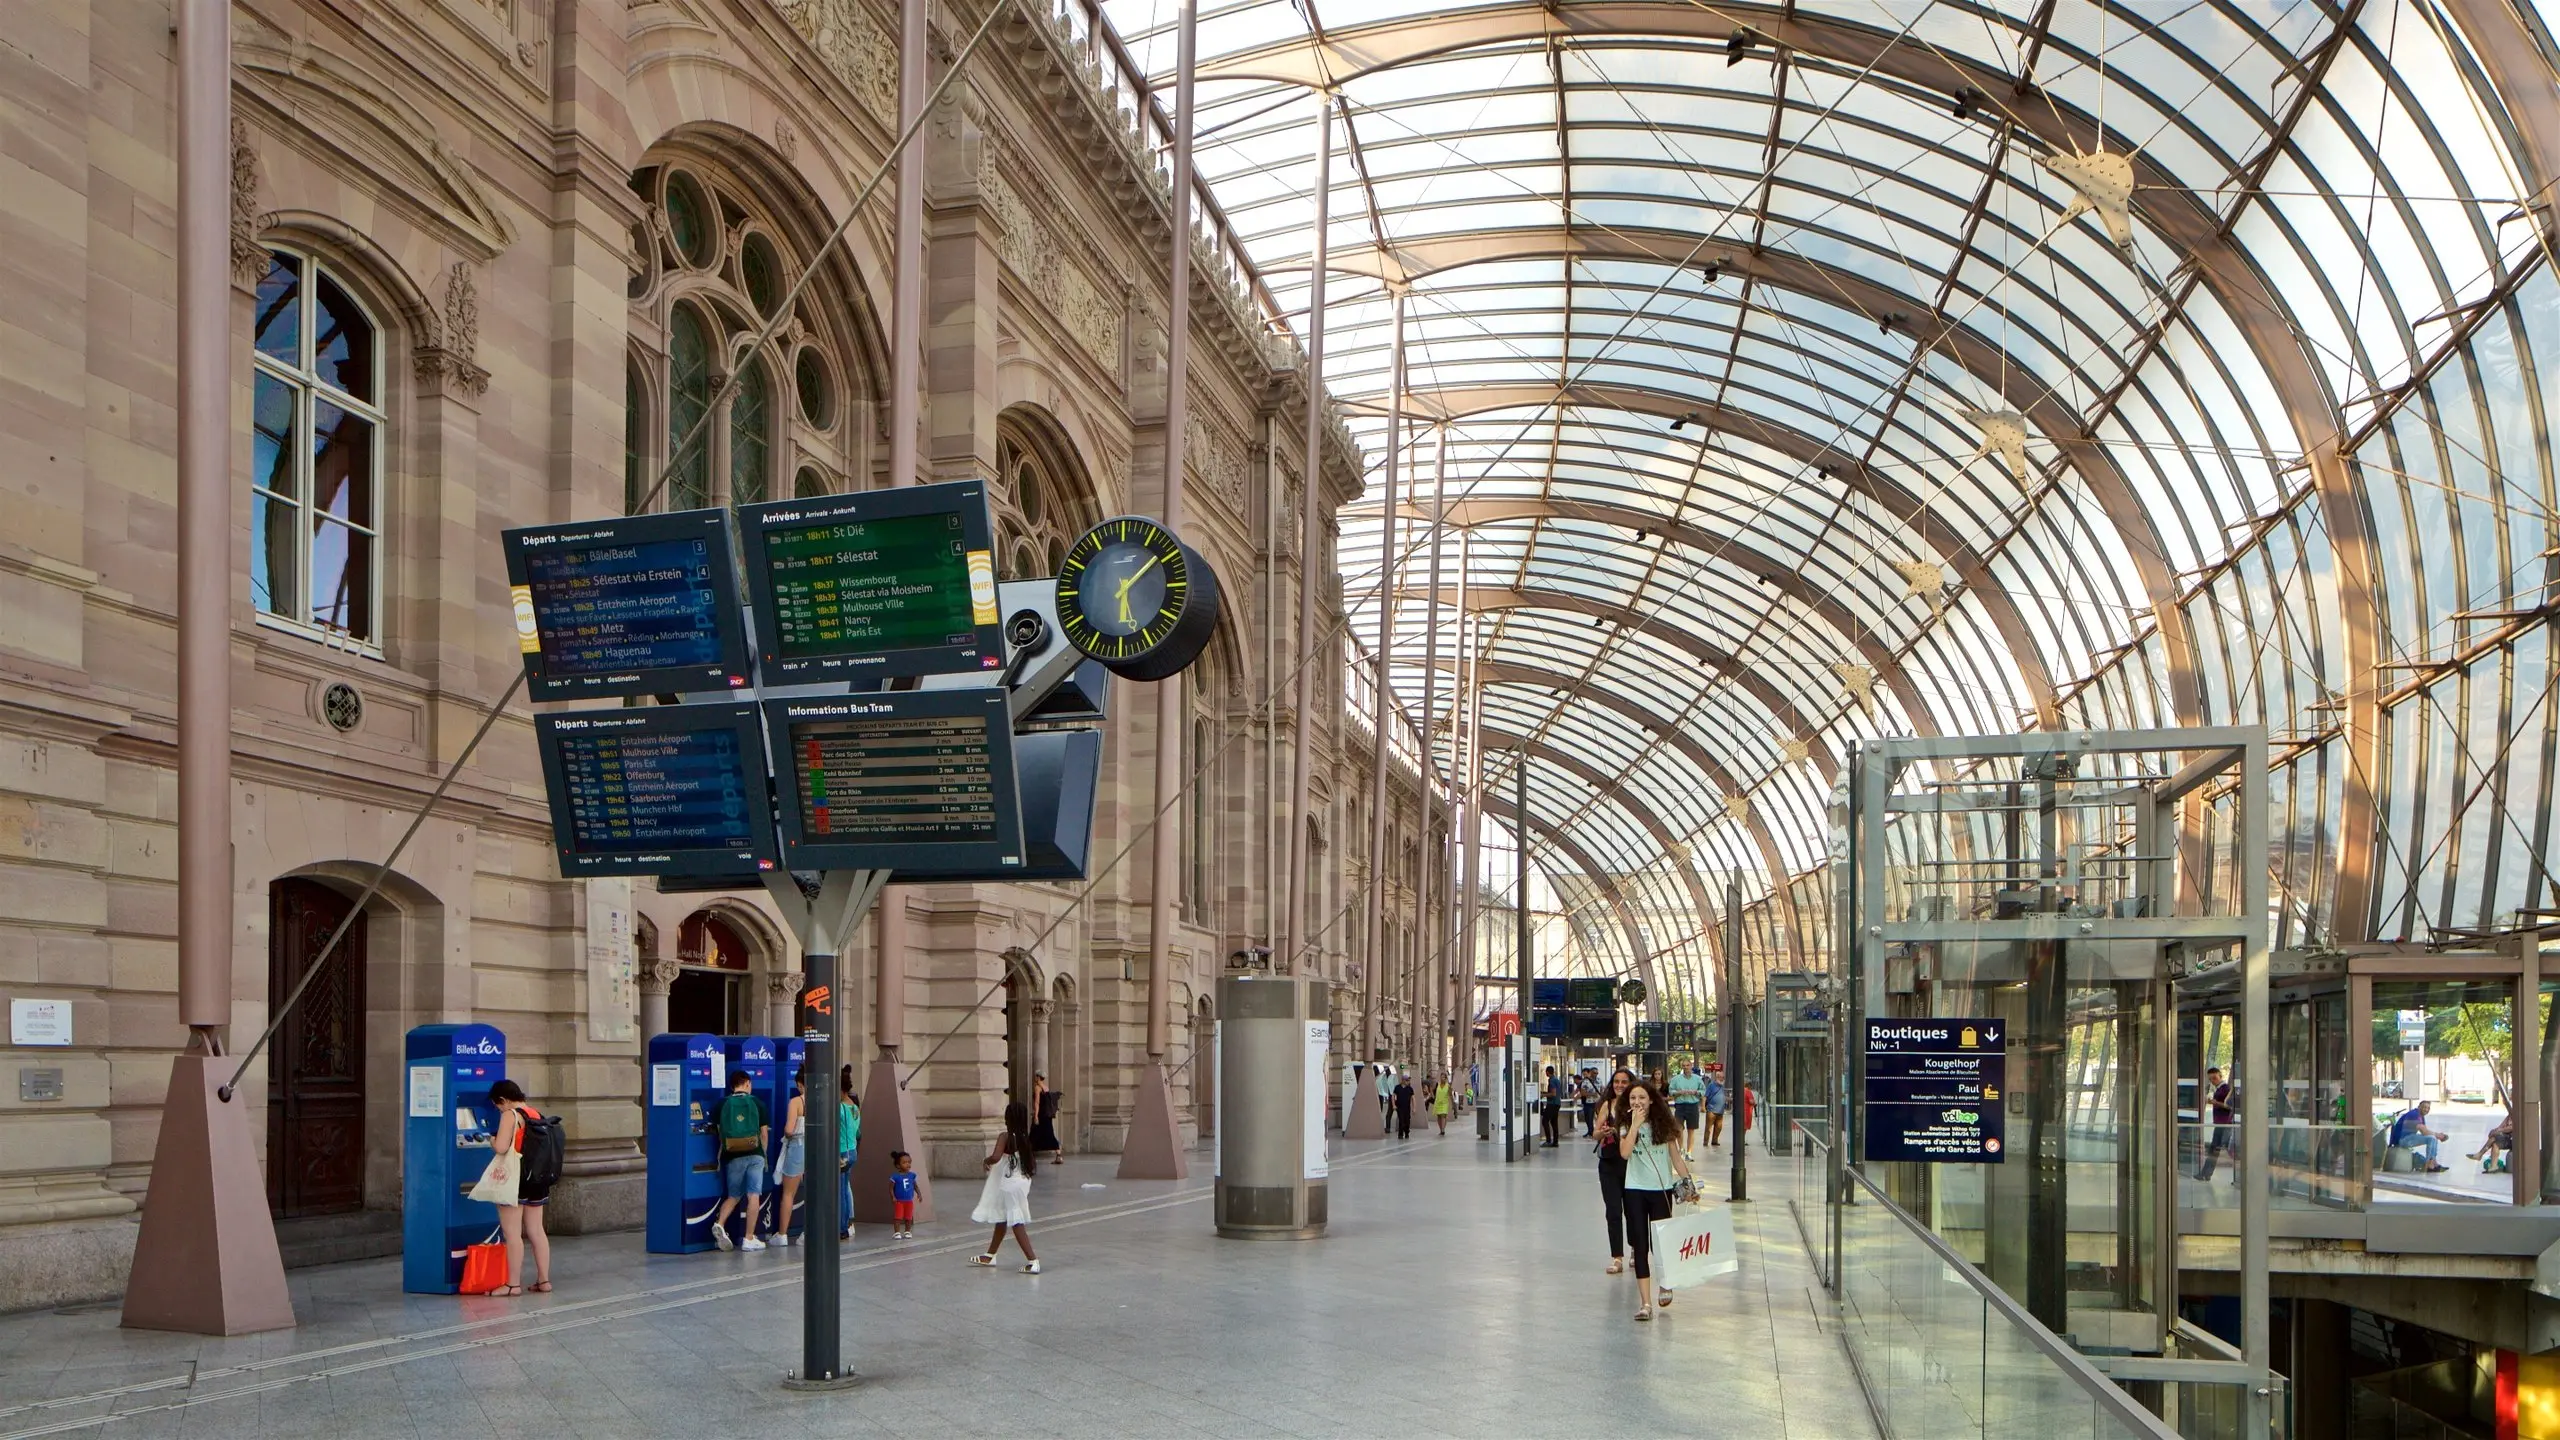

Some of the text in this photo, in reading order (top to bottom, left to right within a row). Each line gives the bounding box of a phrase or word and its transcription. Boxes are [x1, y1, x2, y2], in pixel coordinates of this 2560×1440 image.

[762, 506, 856, 524] Arrivées Arrivals Ankunft
[807, 530, 830, 540] 18h11
[834, 527, 845, 538] St
[847, 524, 864, 536] Dié
[952, 517, 958, 526] 9
[522, 535, 556, 546] Départs
[560, 534, 590, 543] Departures
[590, 543, 702, 562] Bâle/Basel 3
[810, 556, 833, 566] 18h17
[837, 550, 878, 564] Sélestat
[956, 543, 960, 551] 4
[570, 578, 591, 588] 18h25
[594, 574, 632, 586] Sélestat
[633, 572, 646, 582] via
[649, 568, 682, 580] Erstein
[700, 568, 706, 576] 4
[813, 576, 897, 590] 18h37 Wissembourg
[973, 582, 992, 590] WIFI
[815, 584, 932, 602] 18h39 Sélestat via Molsheim
[597, 598, 636, 610] Entzheim
[640, 595, 678, 608] Aéroport
[843, 599, 904, 614] Mulhouse Ville
[818, 616, 872, 628] 18h41 Nancy
[577, 627, 598, 636] 18h49
[601, 624, 624, 634] Metz
[820, 626, 882, 640] 18h41 Paris Est
[628, 634, 655, 644] Réding
[660, 630, 699, 641] Morhange
[604, 646, 652, 660] Haguenau
[783, 662, 798, 670] train
[848, 656, 886, 666] provenance
[608, 675, 640, 683] destination
[788, 703, 893, 716] Informations Bus Tram
[555, 720, 588, 730] Départs
[620, 734, 692, 746] Entzheim Aéroport
[622, 746, 678, 757] Mulhouse Ville
[624, 760, 656, 769] Paris Est
[626, 771, 665, 781] Offenburg
[604, 781, 700, 793] 19h23 Entzheim Aéroport
[668, 804, 682, 813] Hbf
[634, 817, 658, 827] Nancy
[636, 828, 671, 837] Entzheim
[673, 826, 706, 837] Aéroport
[682, 949, 692, 958] Hall
[1871, 1026, 1948, 1042] Boutiques
[457, 1036, 502, 1054] Billets ter
[1870, 1041, 1900, 1050] Niv -1
[690, 1050, 705, 1058] Billets
[758, 1046, 773, 1059] ter
[1925, 1059, 1980, 1070] Kougelhopf
[1958, 1084, 1980, 1093] Paul
[903, 1179, 909, 1188] F
[1680, 1232, 1710, 1261] H&M
